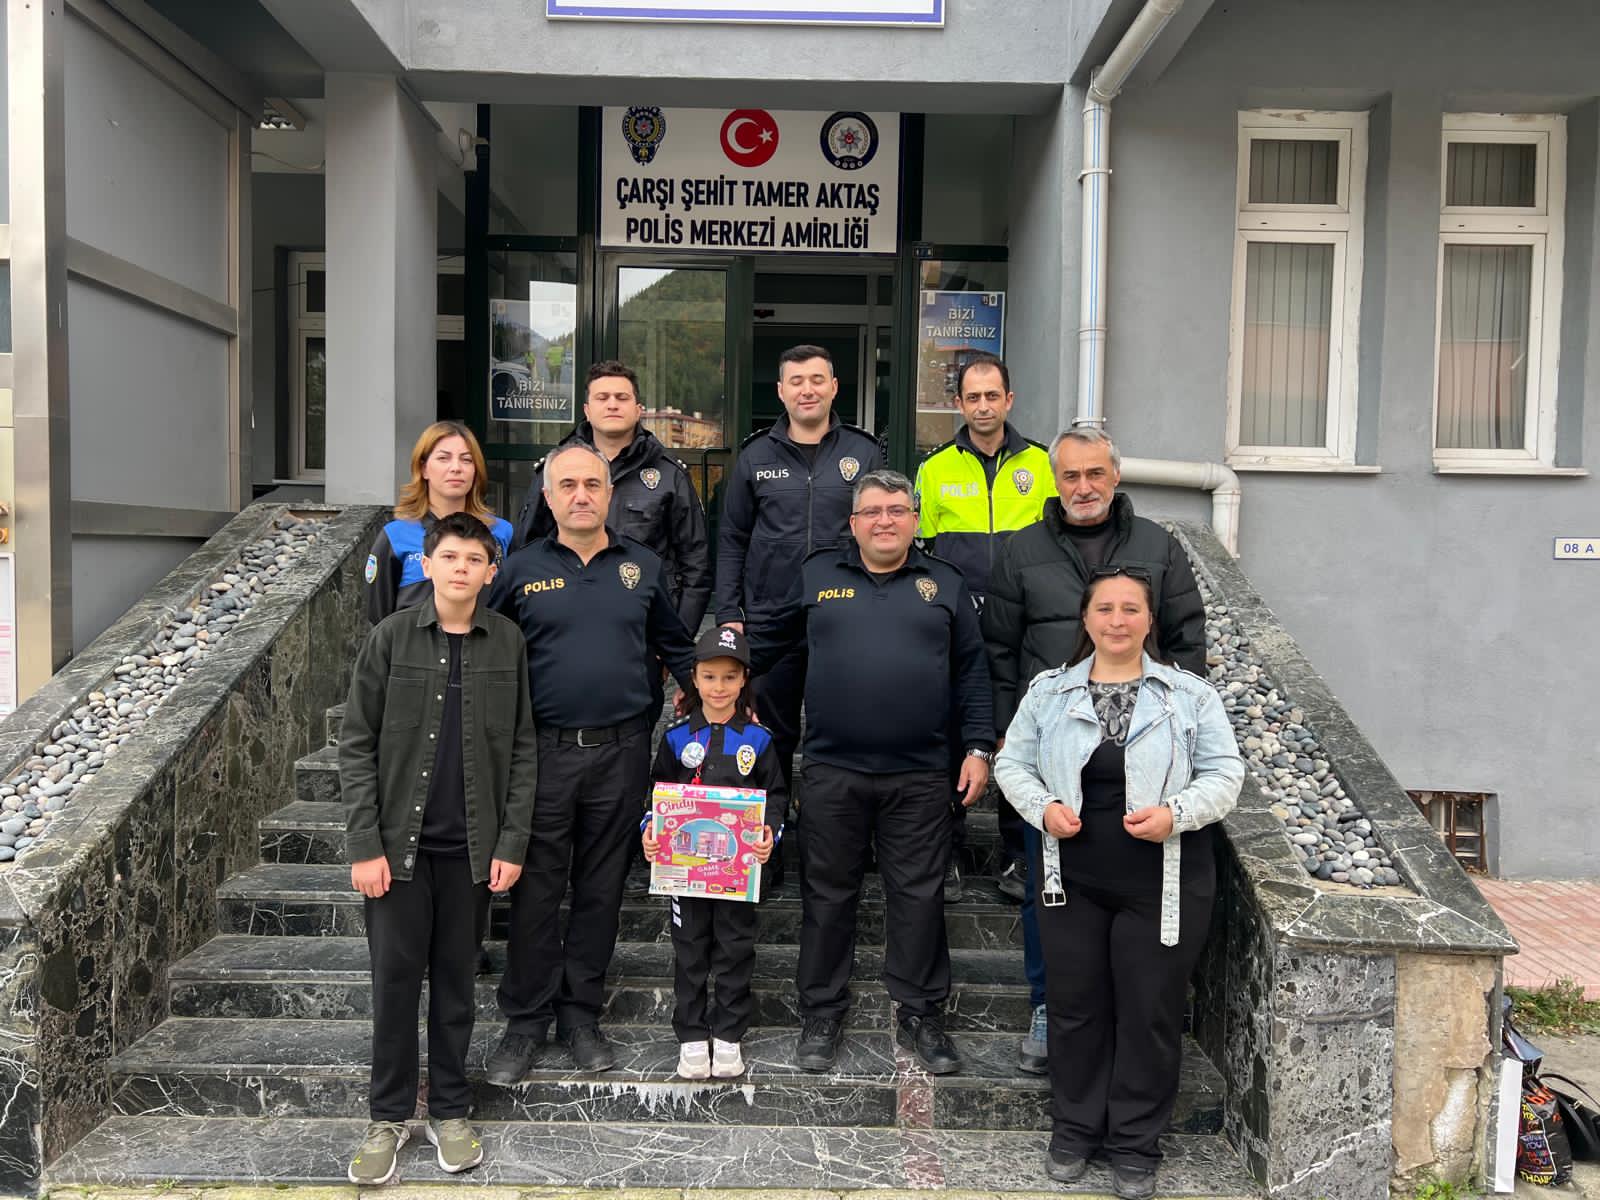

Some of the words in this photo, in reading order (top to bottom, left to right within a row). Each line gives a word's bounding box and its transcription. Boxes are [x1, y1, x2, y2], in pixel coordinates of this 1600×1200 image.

[616, 177, 674, 211] ÇARŞI
[681, 175, 738, 211] ŞEHİT
[742, 180, 809, 208] TAMER
[815, 182, 880, 216] AKTAŞ
[626, 213, 683, 245] POLİS
[690, 216, 776, 248] MERKEZİ
[781, 217, 869, 249] AMİRLİĞİ
[948, 305, 975, 320] BİZİ
[926, 325, 996, 338] TANIRSINIZ
[519, 377, 545, 392] BİZİ
[496, 397, 568, 410] TANIRSINIZ
[1564, 543, 1579, 553] 08
[1585, 543, 1594, 553] A
[656, 799, 695, 815] Cindy
